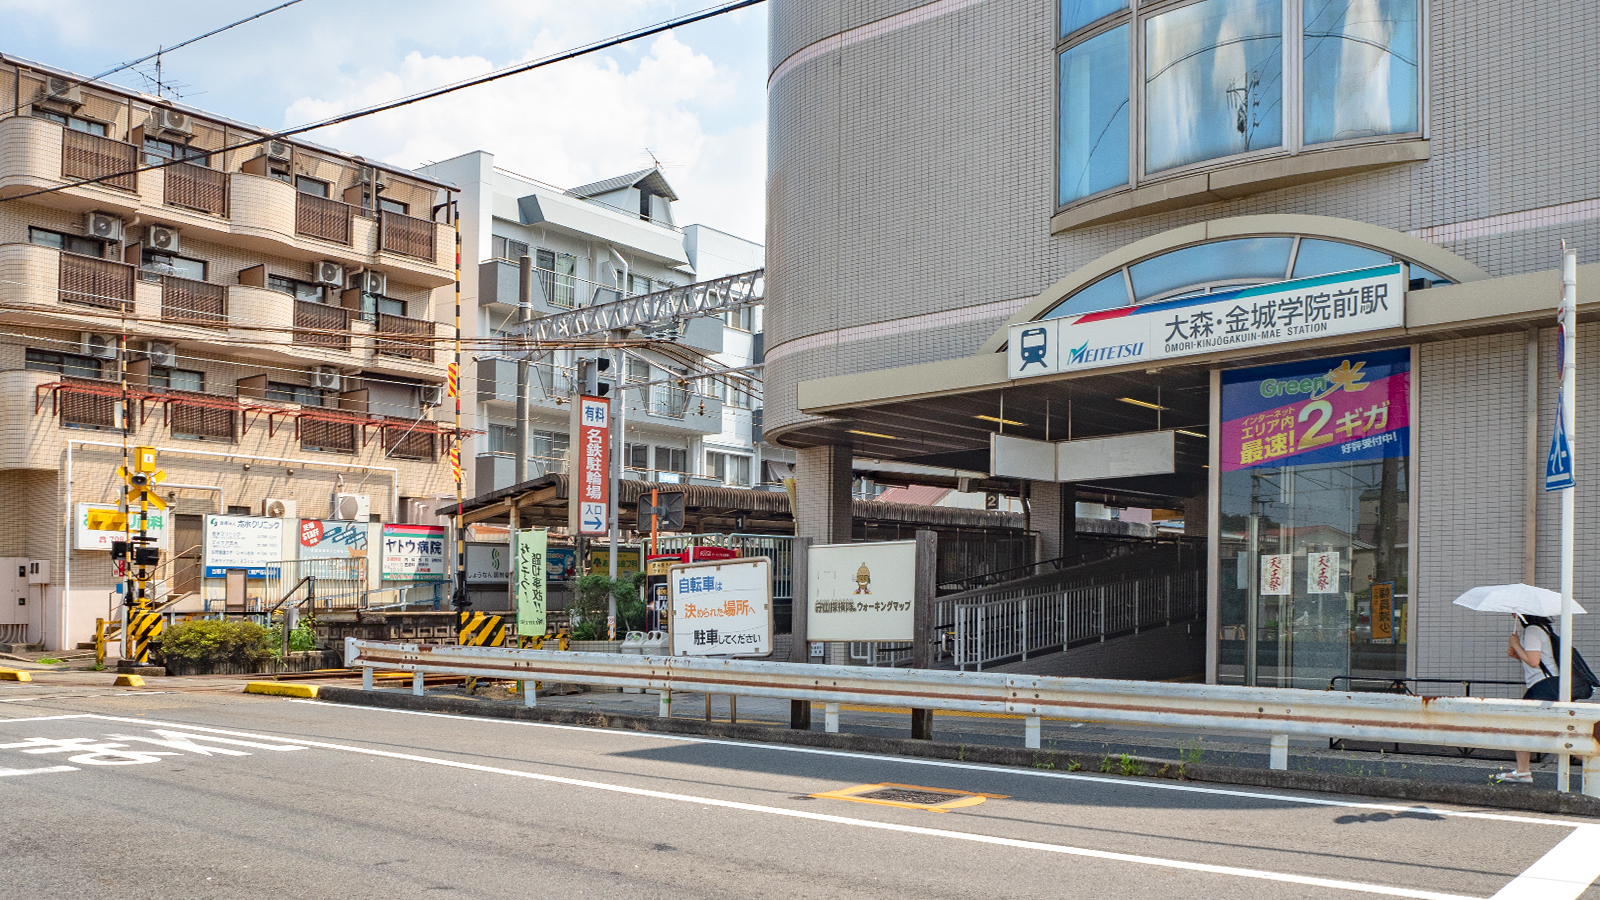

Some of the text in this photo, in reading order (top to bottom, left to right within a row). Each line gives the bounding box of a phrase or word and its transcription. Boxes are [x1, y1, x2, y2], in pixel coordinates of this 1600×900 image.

[1164, 283, 1389, 343] 大森・金城学院前駅
[1287, 322, 1328, 336] STATION
[1066, 339, 1144, 366] MEITETSU
[585, 406, 605, 422] 有料
[1241, 406, 1296, 427] インターネット
[1240, 415, 1294, 440] エリア内
[586, 428, 602, 500] 名鉄駐輪場
[585, 504, 602, 515] 入口
[988, 495, 996, 506] 2
[736, 518, 743, 528] 1
[302, 528, 319, 541] STAFF
[385, 538, 442, 555] ヤトウ病院
[1269, 556, 1281, 592] 天王祭
[1317, 555, 1329, 591] 天王祭
[679, 575, 723, 595] 自転車は
[684, 599, 756, 619] 決められた場所へ
[693, 628, 762, 646] 駐車してください
